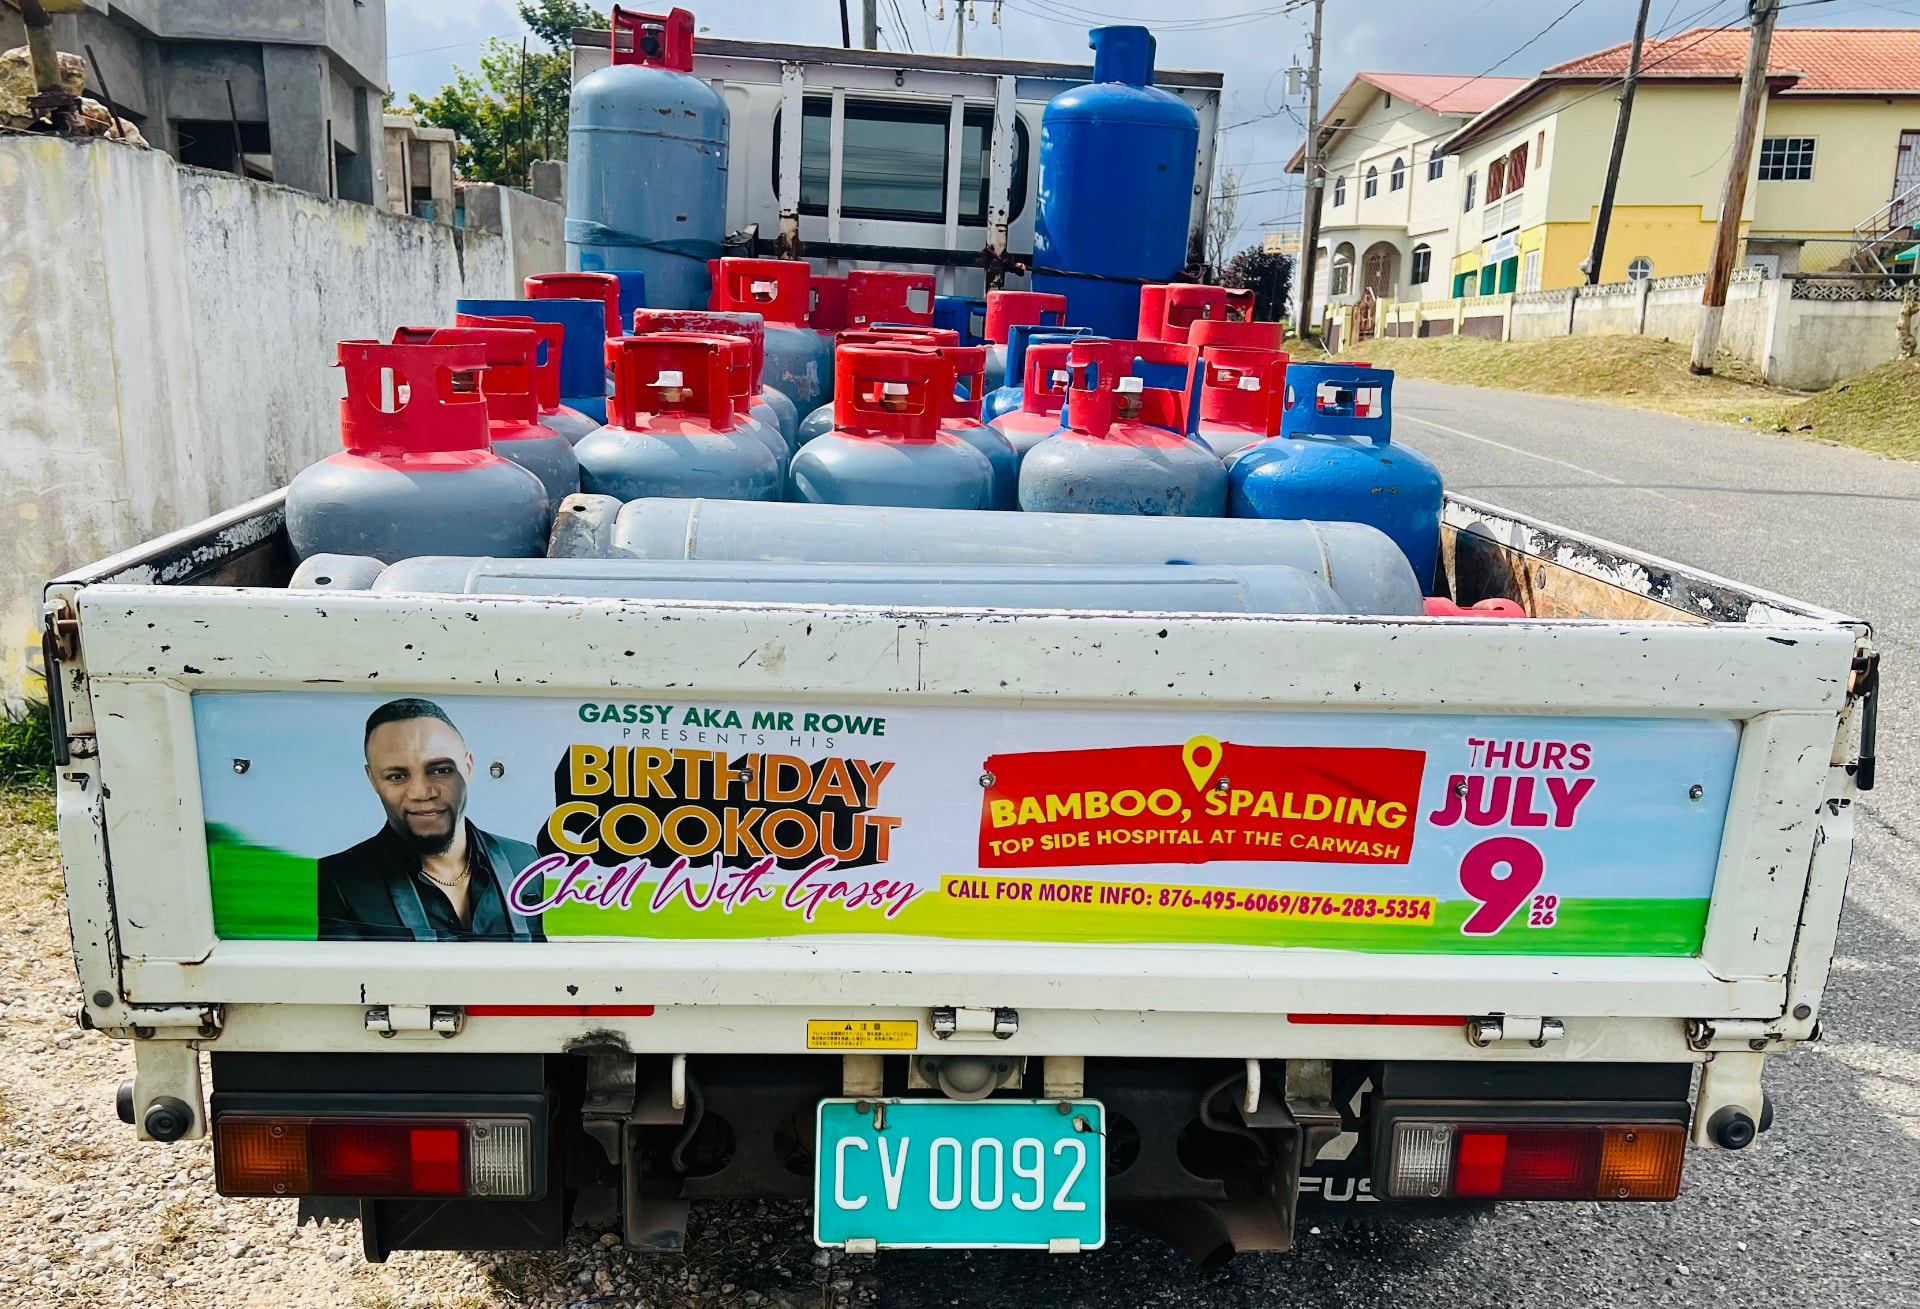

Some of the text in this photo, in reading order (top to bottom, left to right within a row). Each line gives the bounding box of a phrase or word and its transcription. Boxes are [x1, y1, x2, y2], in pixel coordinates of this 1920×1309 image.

[578, 703, 886, 737] GASSY AKA MR ROWE
[623, 728, 835, 749] PRESENTS HIS
[1468, 738, 1592, 770] THURS
[569, 744, 896, 808] BIRTHDAY
[990, 788, 1408, 829] BAMBOO, SPALDING
[1429, 774, 1596, 828] JULY
[548, 801, 902, 863] COOKOUT
[989, 829, 1401, 860] TOP SIDE HOSPITAL AT THE CARWASH
[510, 852, 925, 920] Chill With Gassy
[947, 880, 1431, 919] CALL FOR MORE INFO: 876-495-6069/876-283-5354
[1460, 836, 1543, 934] 9
[1533, 895, 1557, 910] 20
[1530, 911, 1554, 925] 26
[834, 1136, 1087, 1211] CV 0092
